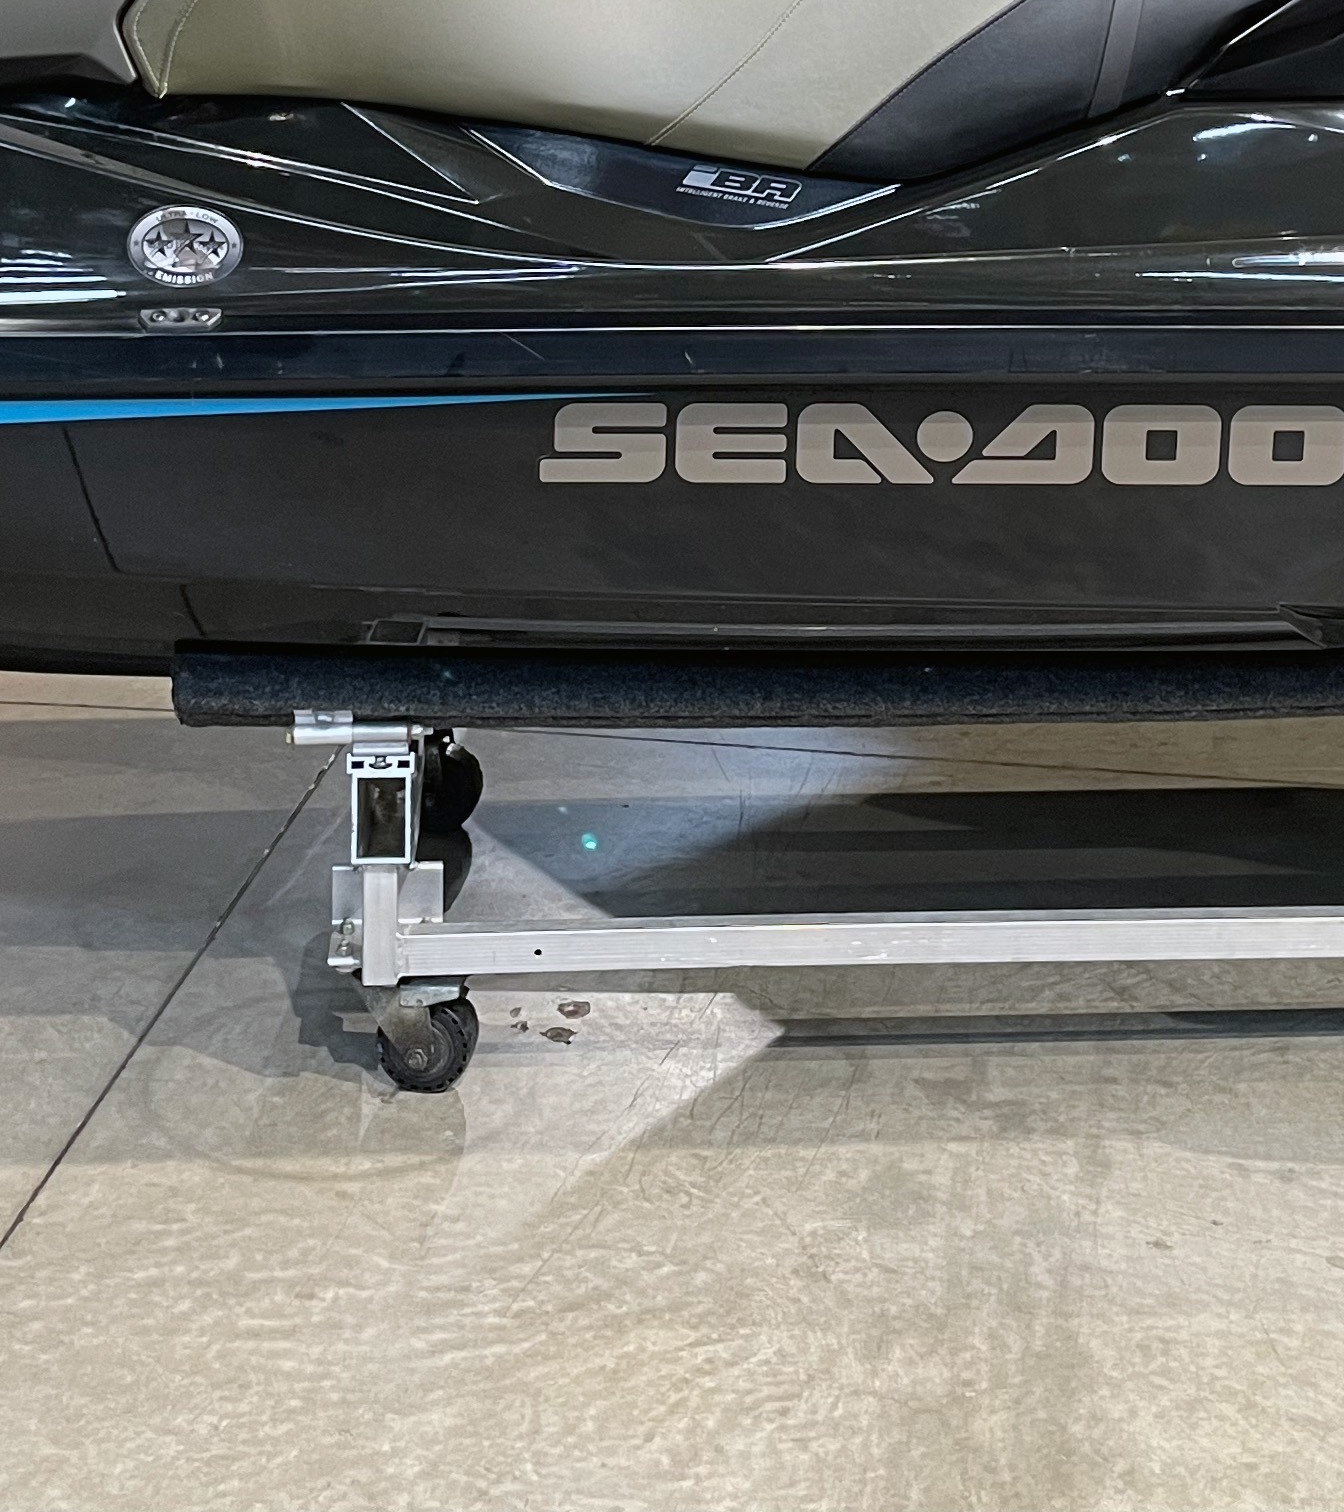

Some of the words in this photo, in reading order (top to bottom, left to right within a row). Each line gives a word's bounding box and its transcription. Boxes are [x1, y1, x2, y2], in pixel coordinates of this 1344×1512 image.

[676, 186, 723, 199] INTELLIGENT
[723, 193, 748, 203] BRAKE
[756, 199, 789, 209] REVERSE
[196, 212, 219, 224] LOW
[154, 270, 214, 285] EMISSION
